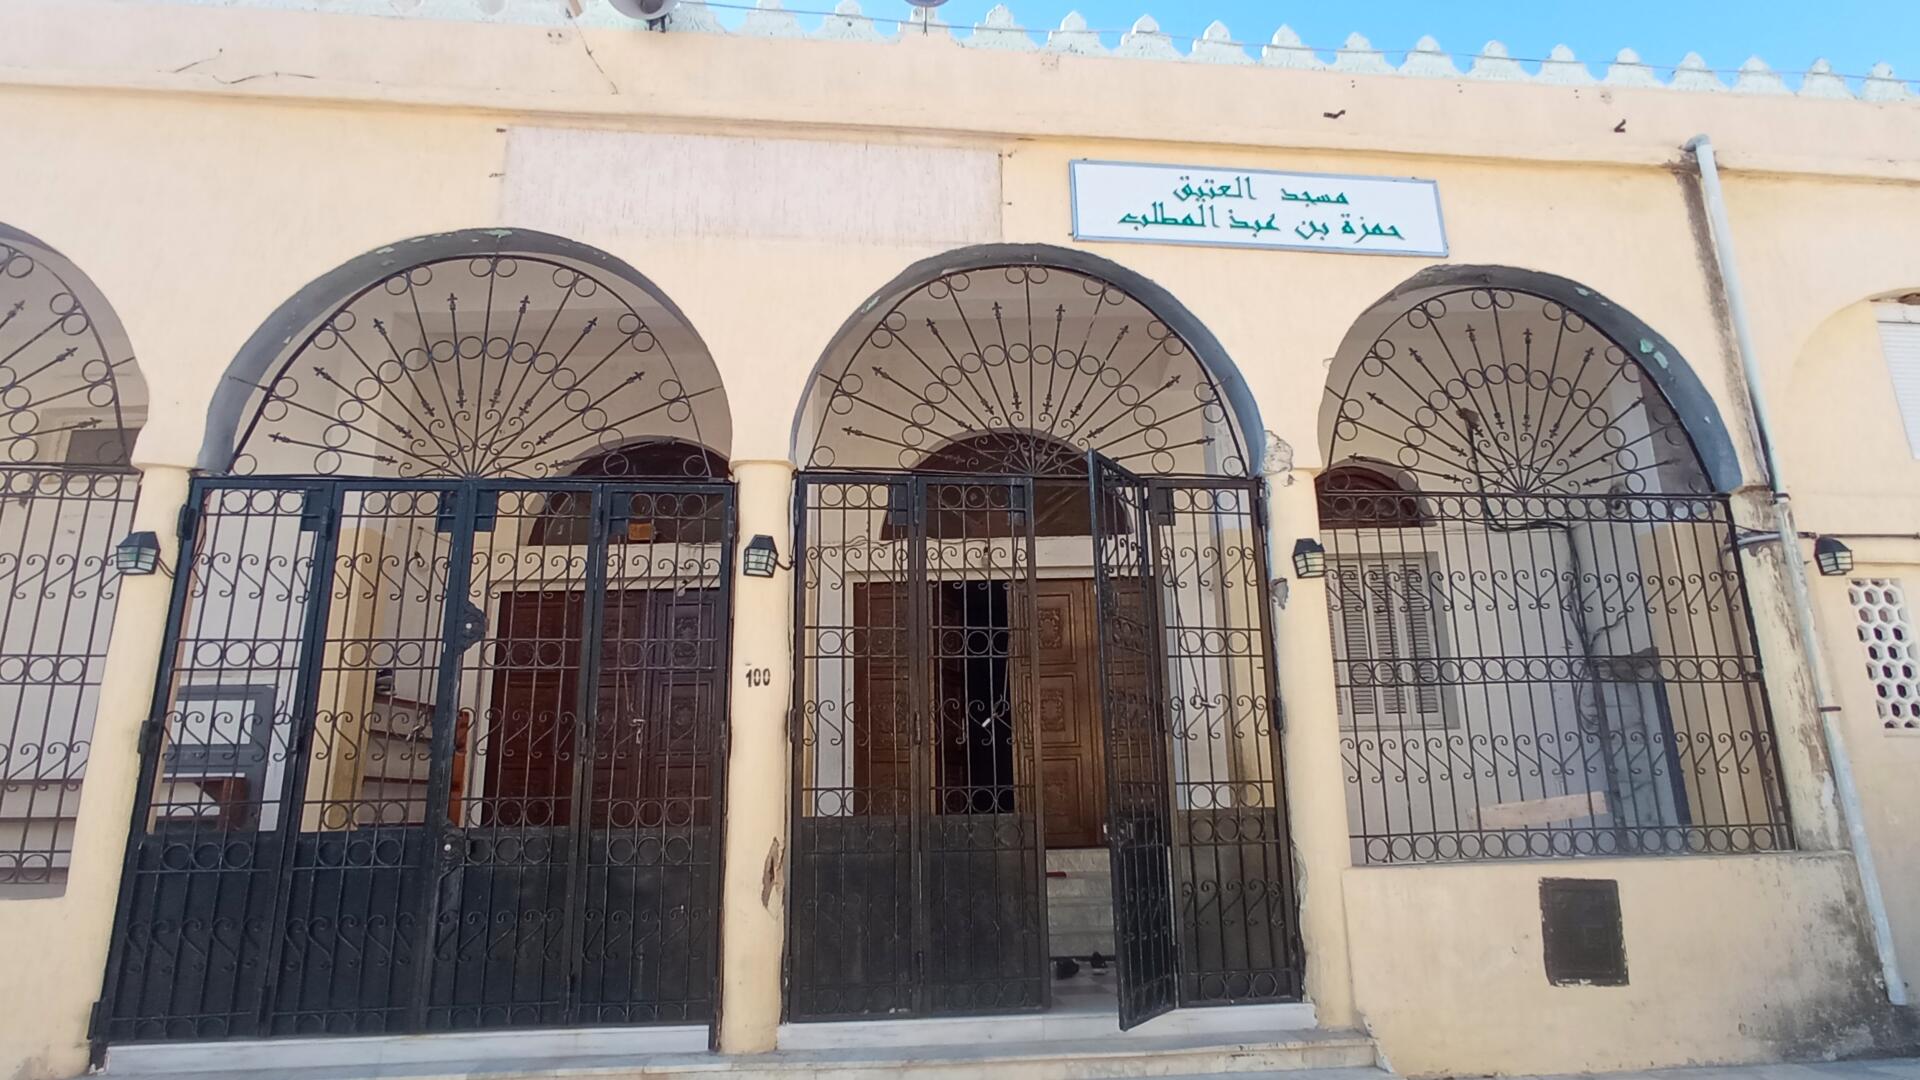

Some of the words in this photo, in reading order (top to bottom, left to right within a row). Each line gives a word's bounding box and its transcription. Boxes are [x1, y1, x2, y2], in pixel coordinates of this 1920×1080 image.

[1172, 175, 1257, 202] العتيق
[1280, 188, 1349, 208] مسجد
[1117, 201, 1220, 231] المطلب
[1294, 220, 1330, 241] بن
[1340, 213, 1406, 244] حمزة
[745, 668, 771, 688] 100
